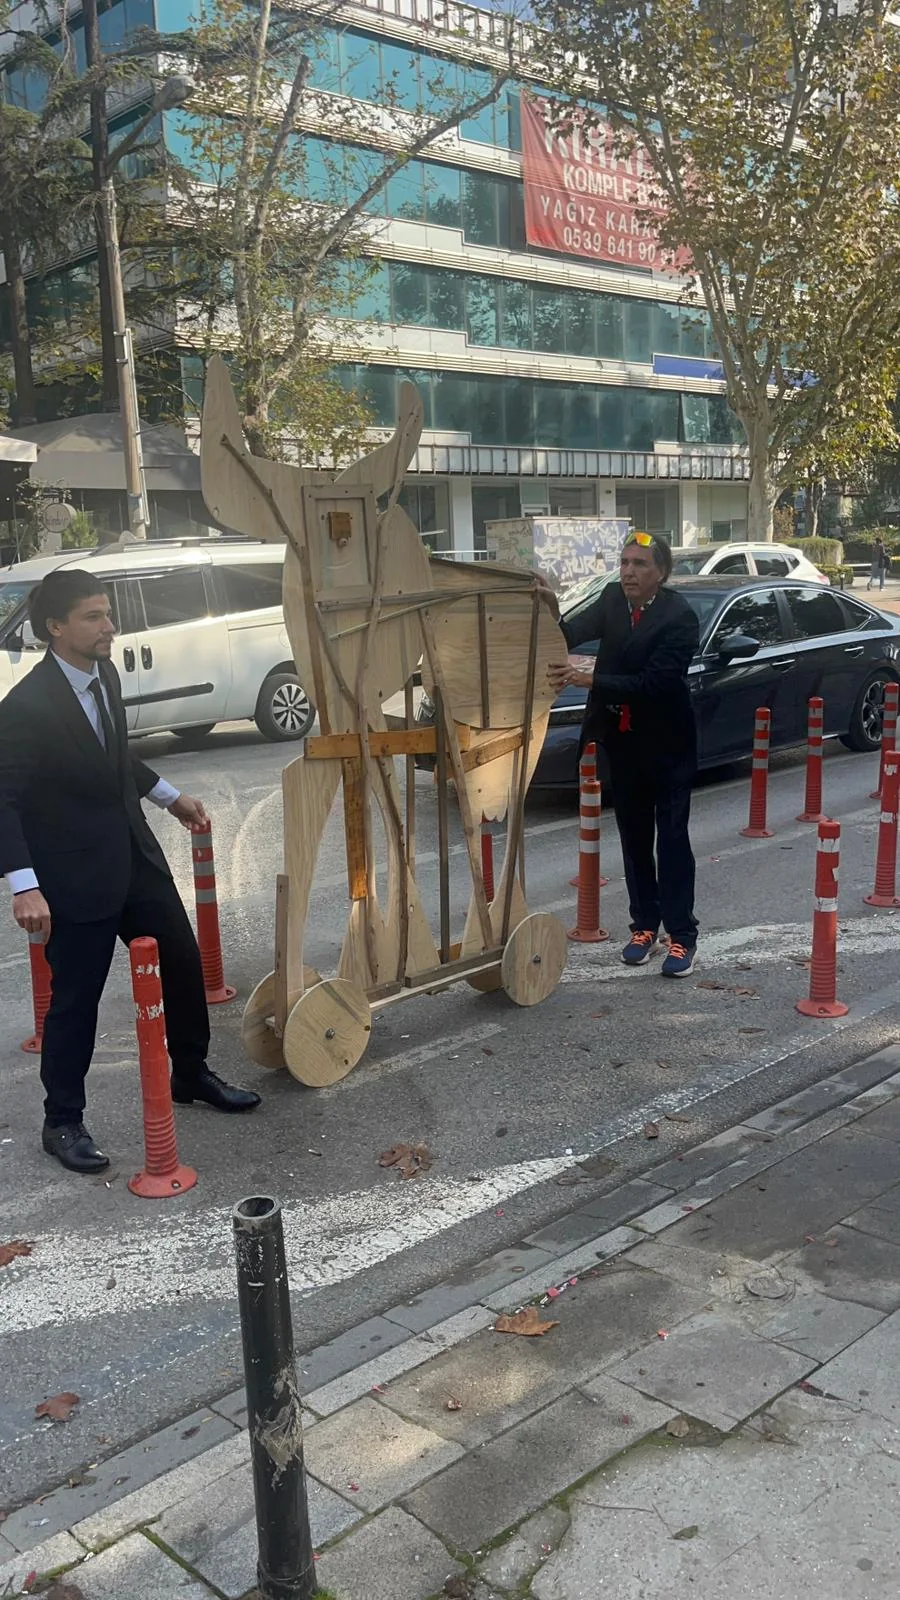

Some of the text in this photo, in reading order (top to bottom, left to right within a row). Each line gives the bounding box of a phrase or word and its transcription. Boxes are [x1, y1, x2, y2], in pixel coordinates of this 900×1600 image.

[563, 164, 634, 203] KOMPLE
[541, 196, 596, 226] YAĞIZ
[563, 227, 601, 252] 0539
[607, 235, 633, 258] 641
[638, 242, 656, 263] 90
